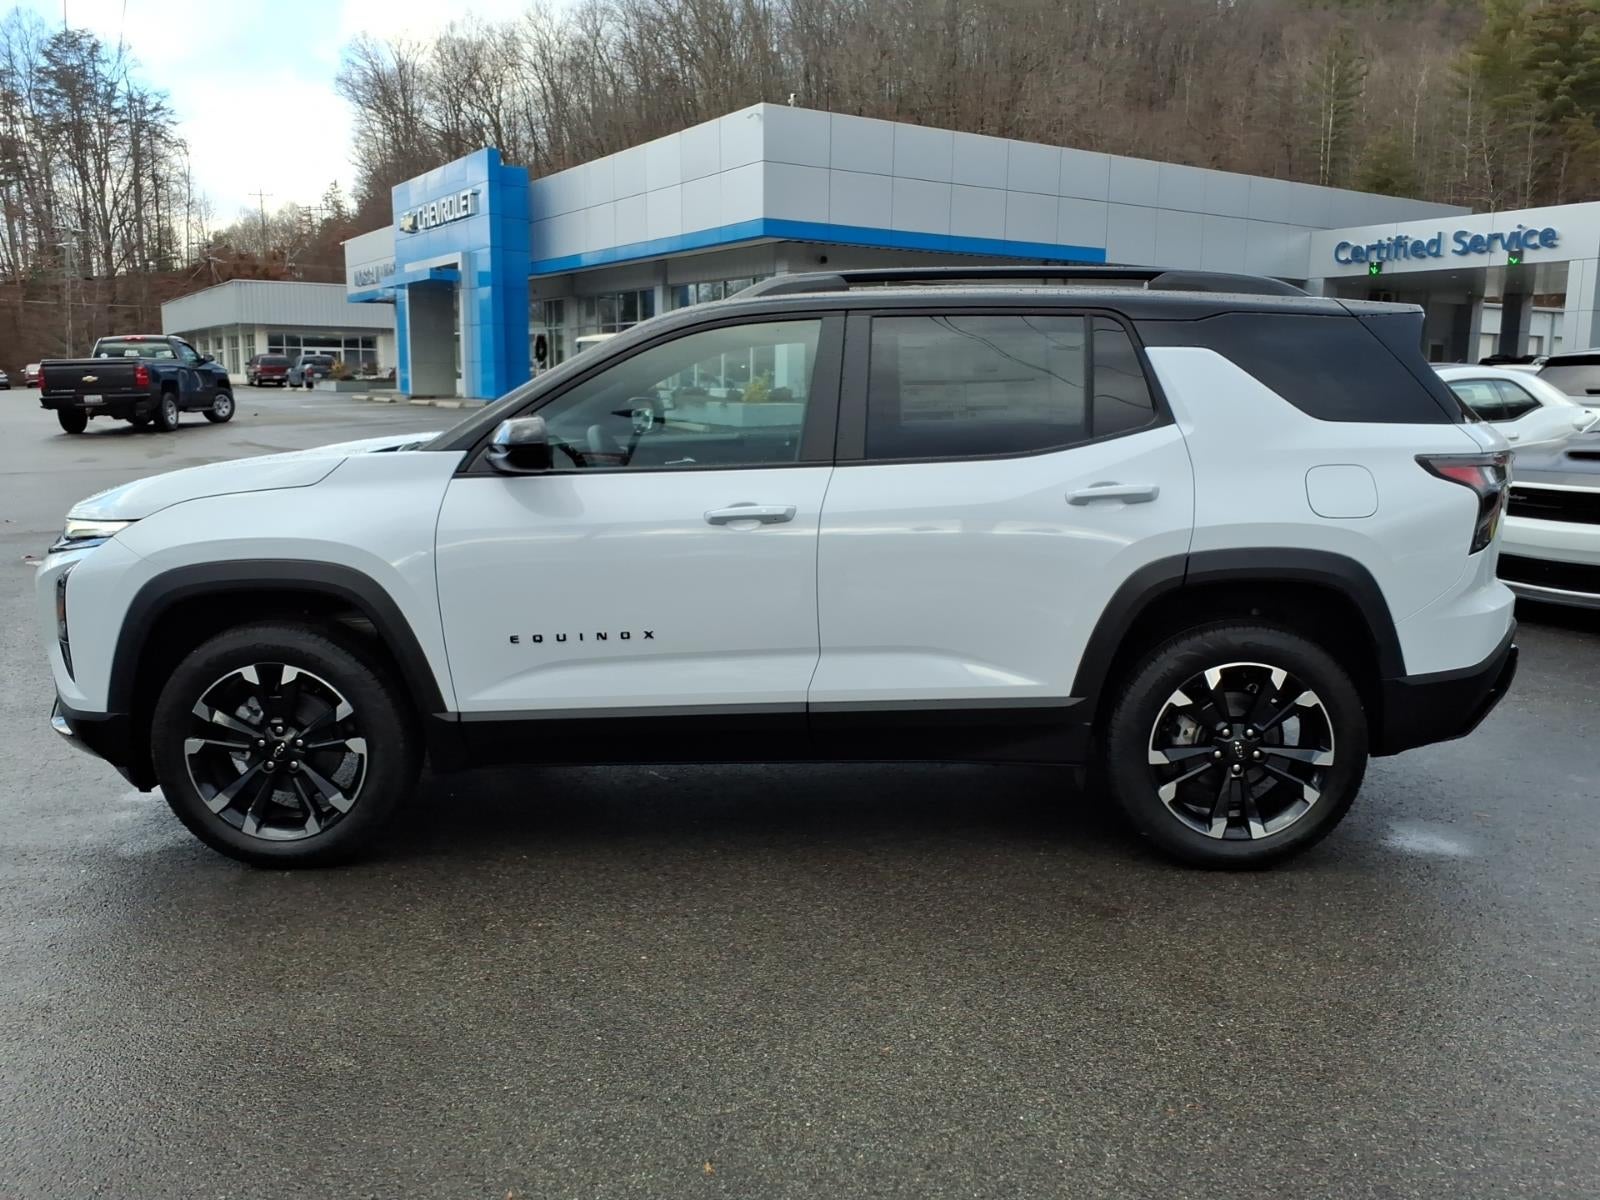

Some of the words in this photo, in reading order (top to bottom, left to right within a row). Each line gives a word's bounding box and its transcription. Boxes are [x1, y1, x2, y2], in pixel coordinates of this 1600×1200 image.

[417, 189, 476, 229] CHEVROLET
[1334, 232, 1444, 264] Certified
[1452, 224, 1560, 256] Service
[509, 630, 655, 644] EQUINOX
